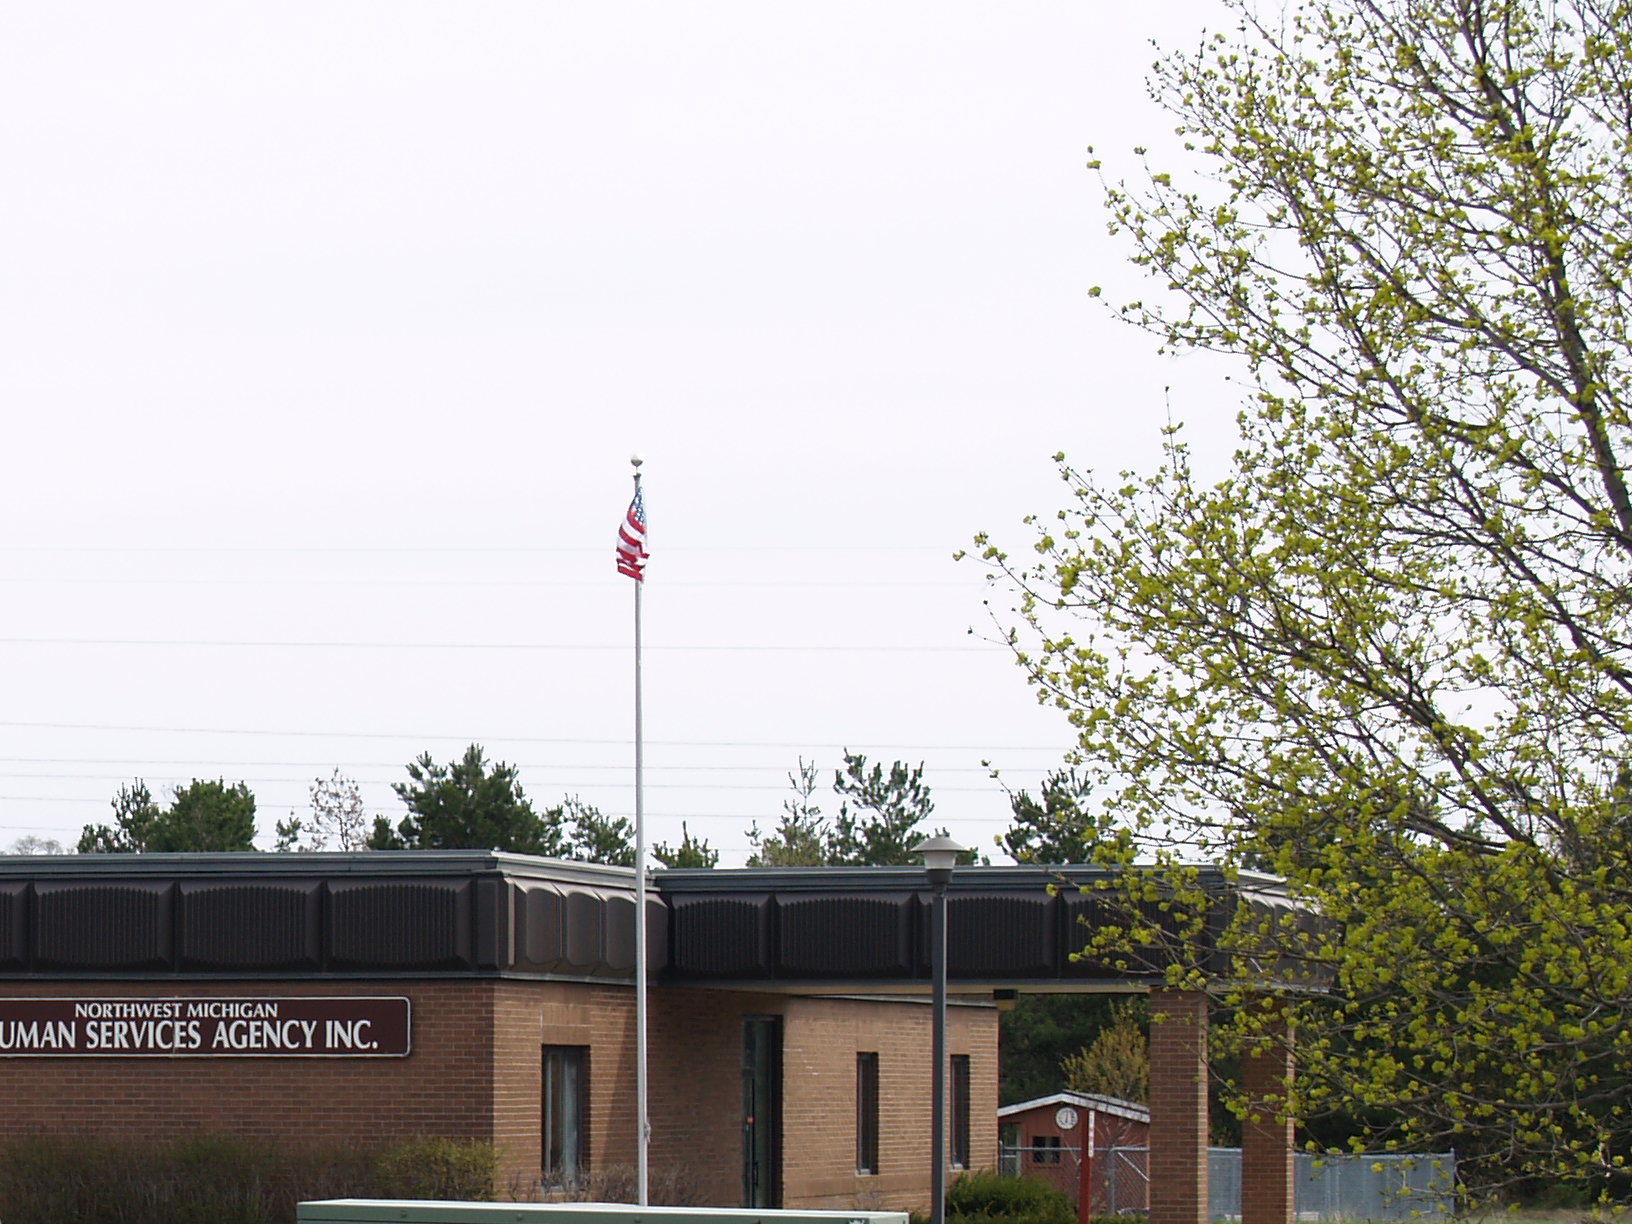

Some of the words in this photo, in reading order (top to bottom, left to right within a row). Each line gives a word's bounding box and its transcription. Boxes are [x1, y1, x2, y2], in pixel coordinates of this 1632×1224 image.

[75, 1003, 183, 1018] NORTHWEST
[186, 1003, 278, 1018] MICHIGAN
[85, 1020, 202, 1049] SERVICES
[211, 1020, 317, 1049] AGENCY
[325, 1020, 378, 1049] INC.
